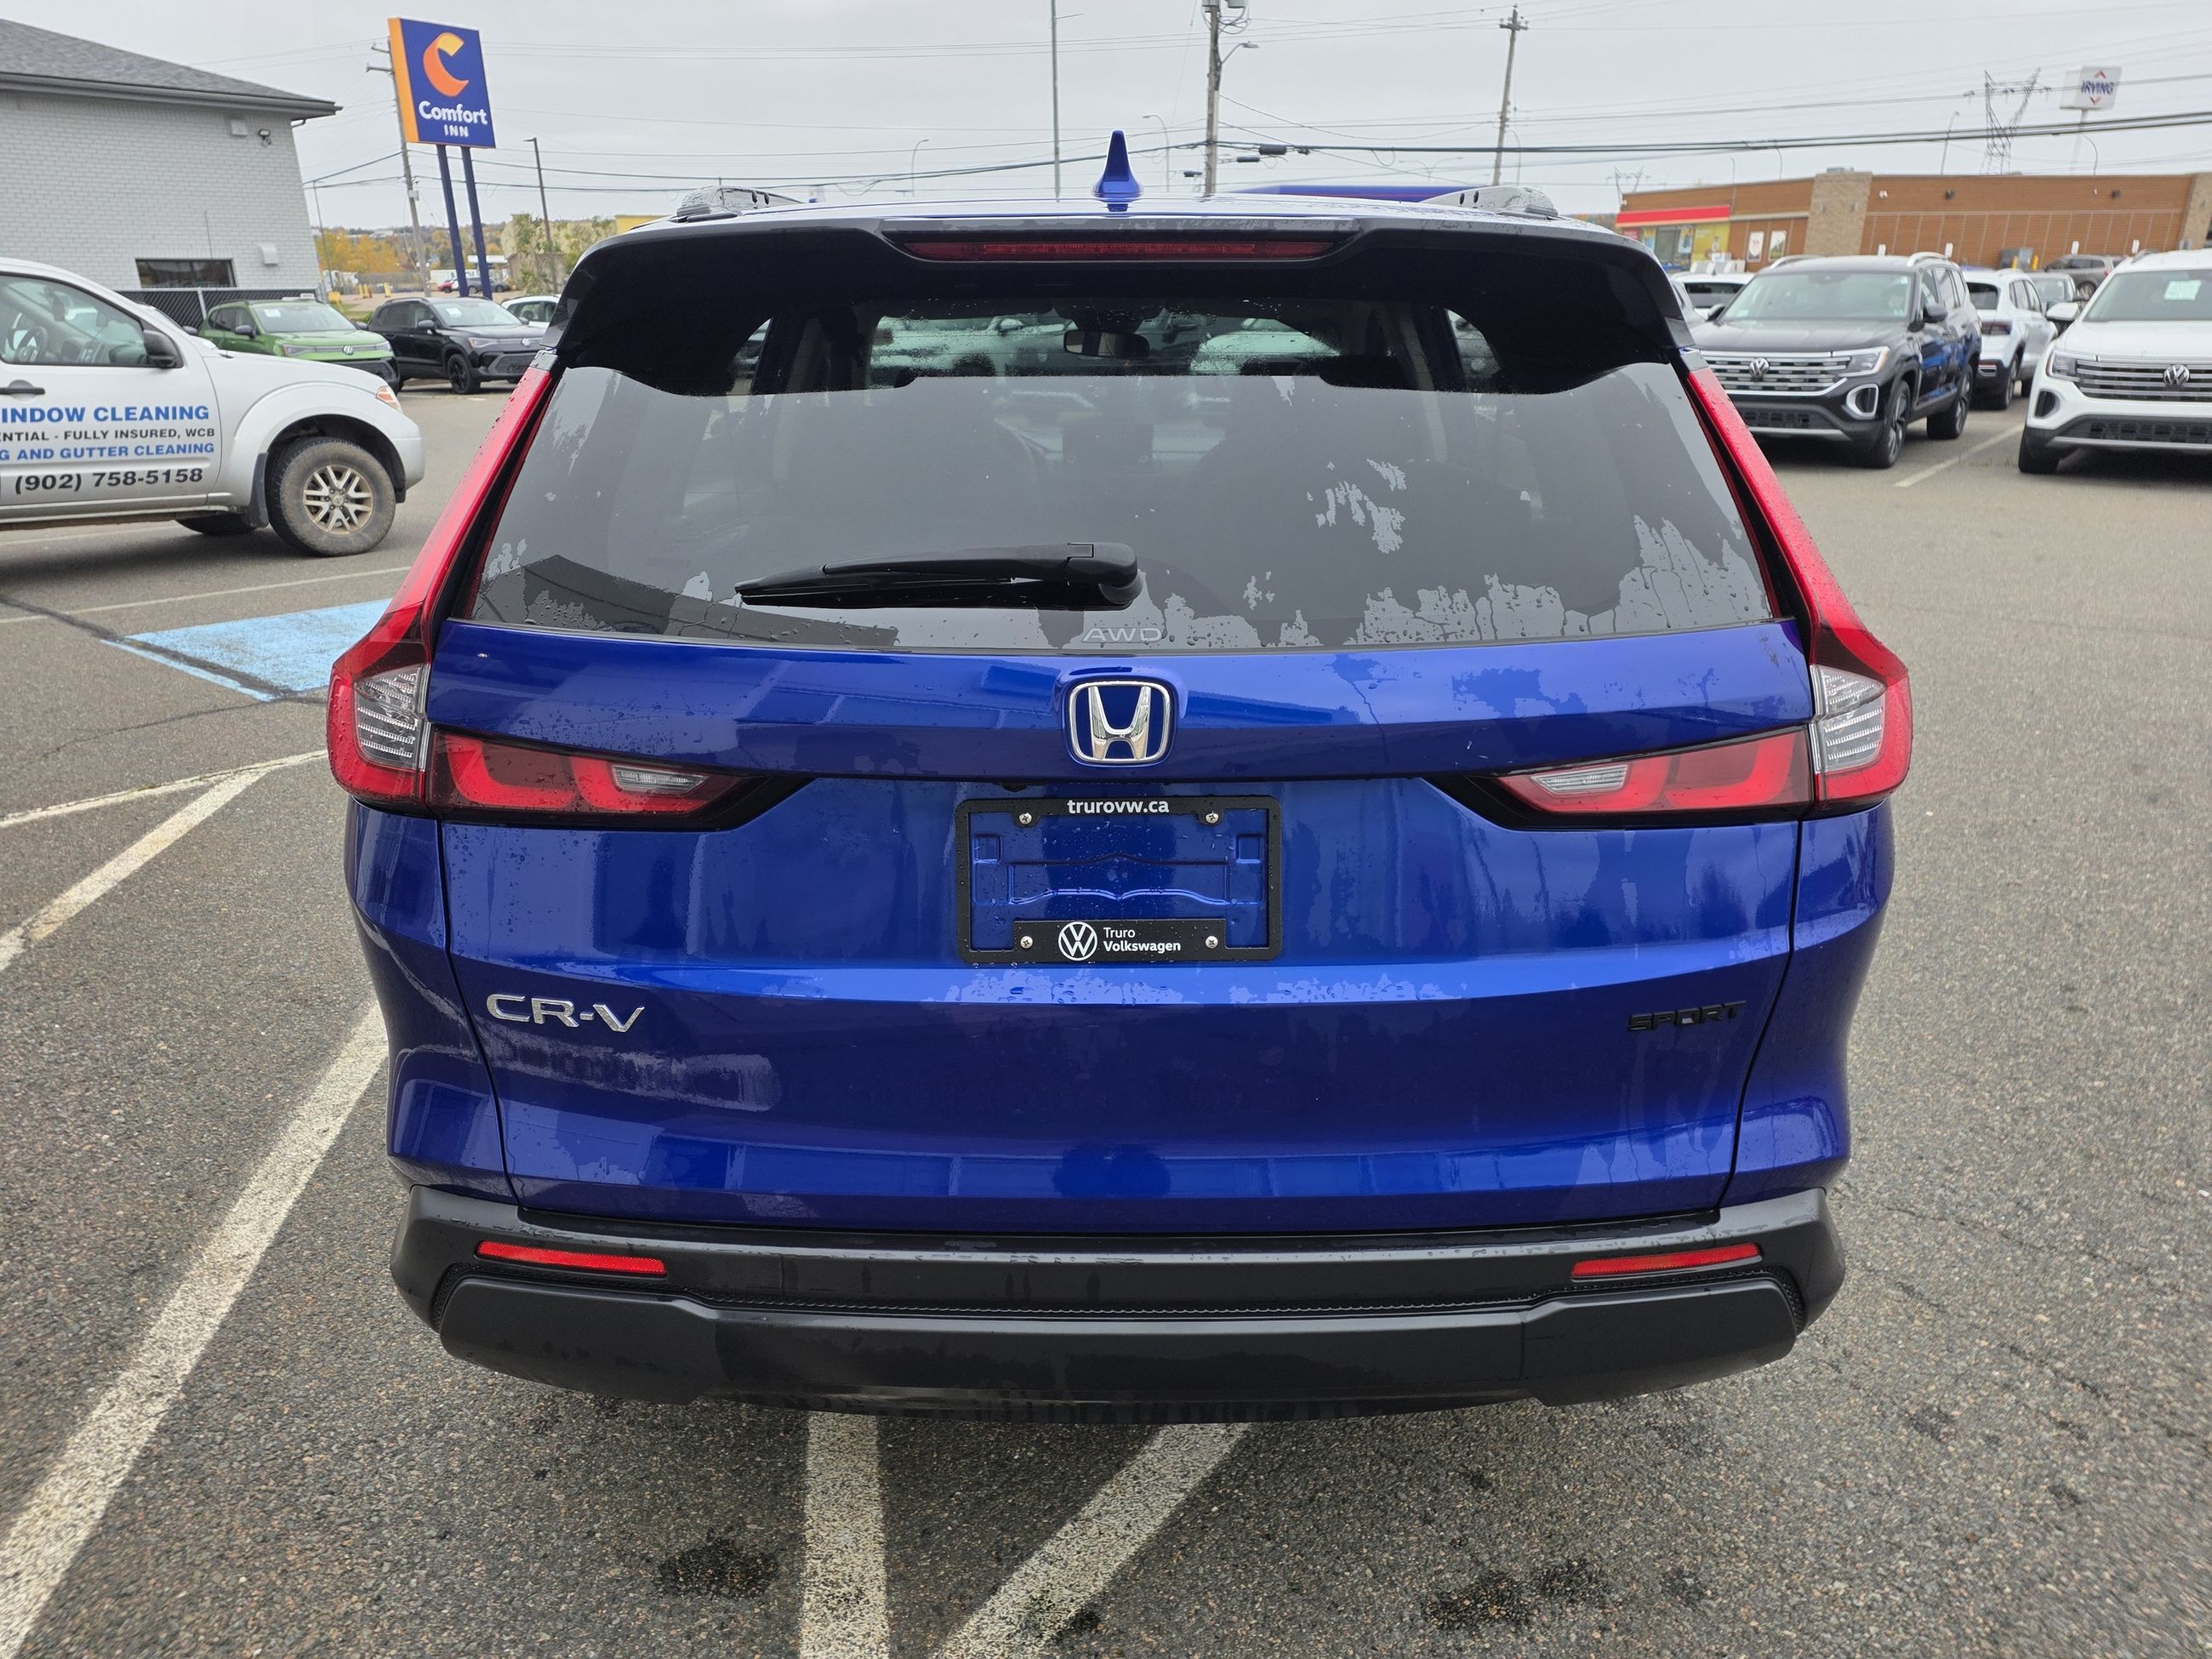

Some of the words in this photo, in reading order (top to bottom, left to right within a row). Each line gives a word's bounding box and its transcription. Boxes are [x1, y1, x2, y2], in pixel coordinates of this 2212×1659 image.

[2081, 80, 2115, 95] IRVING
[419, 100, 488, 125] Comfort
[443, 124, 469, 138] INN
[0, 408, 86, 423] INDOW
[93, 405, 209, 422] CLEANING
[0, 431, 49, 442] NTIAL
[64, 430, 110, 441] FULLY
[115, 428, 180, 439] INSURED,
[185, 428, 215, 437] WCB
[17, 448, 54, 460] AND
[60, 445, 129, 459] GUTTER
[134, 442, 214, 456] CLEANING
[15, 473, 83, 495] (902)
[92, 468, 203, 487] 758-5158
[1081, 626, 1162, 644] AWD
[1067, 798, 1170, 814] trurovw.ca
[1103, 926, 1136, 939] Truro
[1103, 940, 1182, 953] Volkswagen
[486, 993, 646, 1033] CR-V
[1628, 1000, 1747, 1031] SPORT
